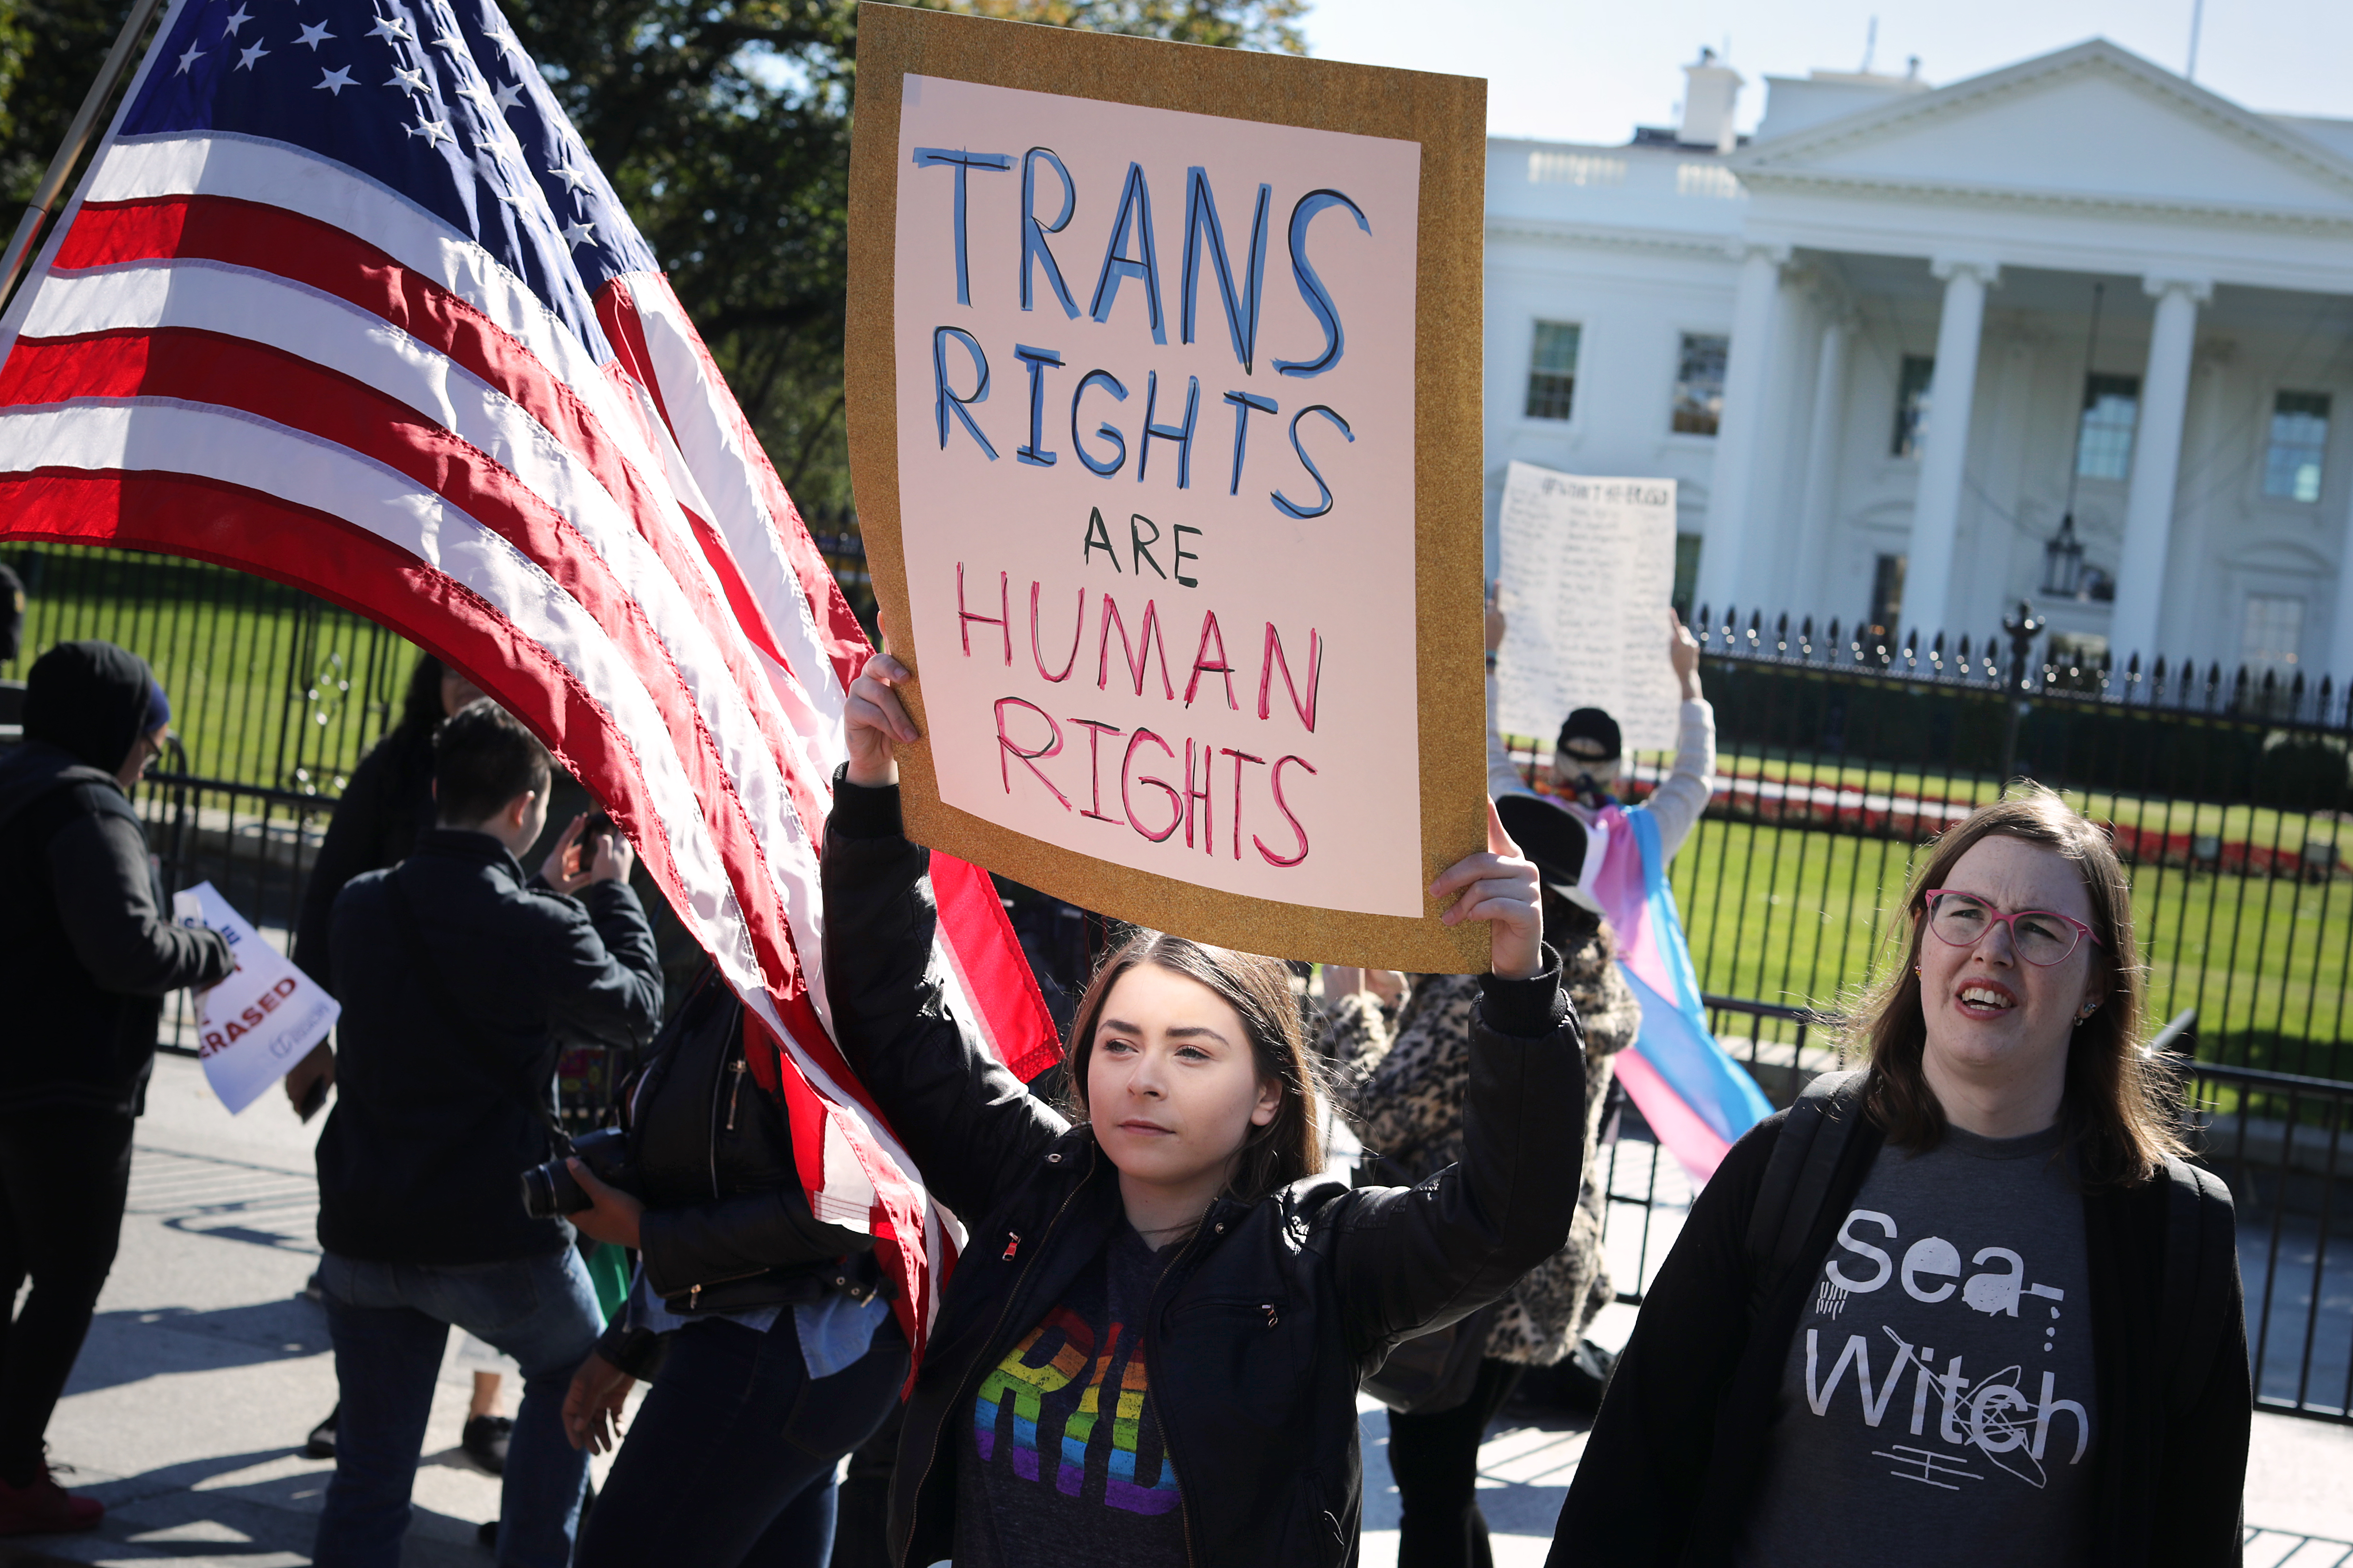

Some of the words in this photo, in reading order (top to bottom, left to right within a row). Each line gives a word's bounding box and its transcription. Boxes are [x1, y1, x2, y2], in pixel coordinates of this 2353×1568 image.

[913, 145, 1372, 378] TRANS
[933, 325, 1355, 519] RIGHTS
[1084, 506, 1202, 588] ARE
[957, 561, 1322, 733] HUMAN
[994, 697, 1318, 867] RIGHTS
[1806, 1328, 2089, 1464] Witch
